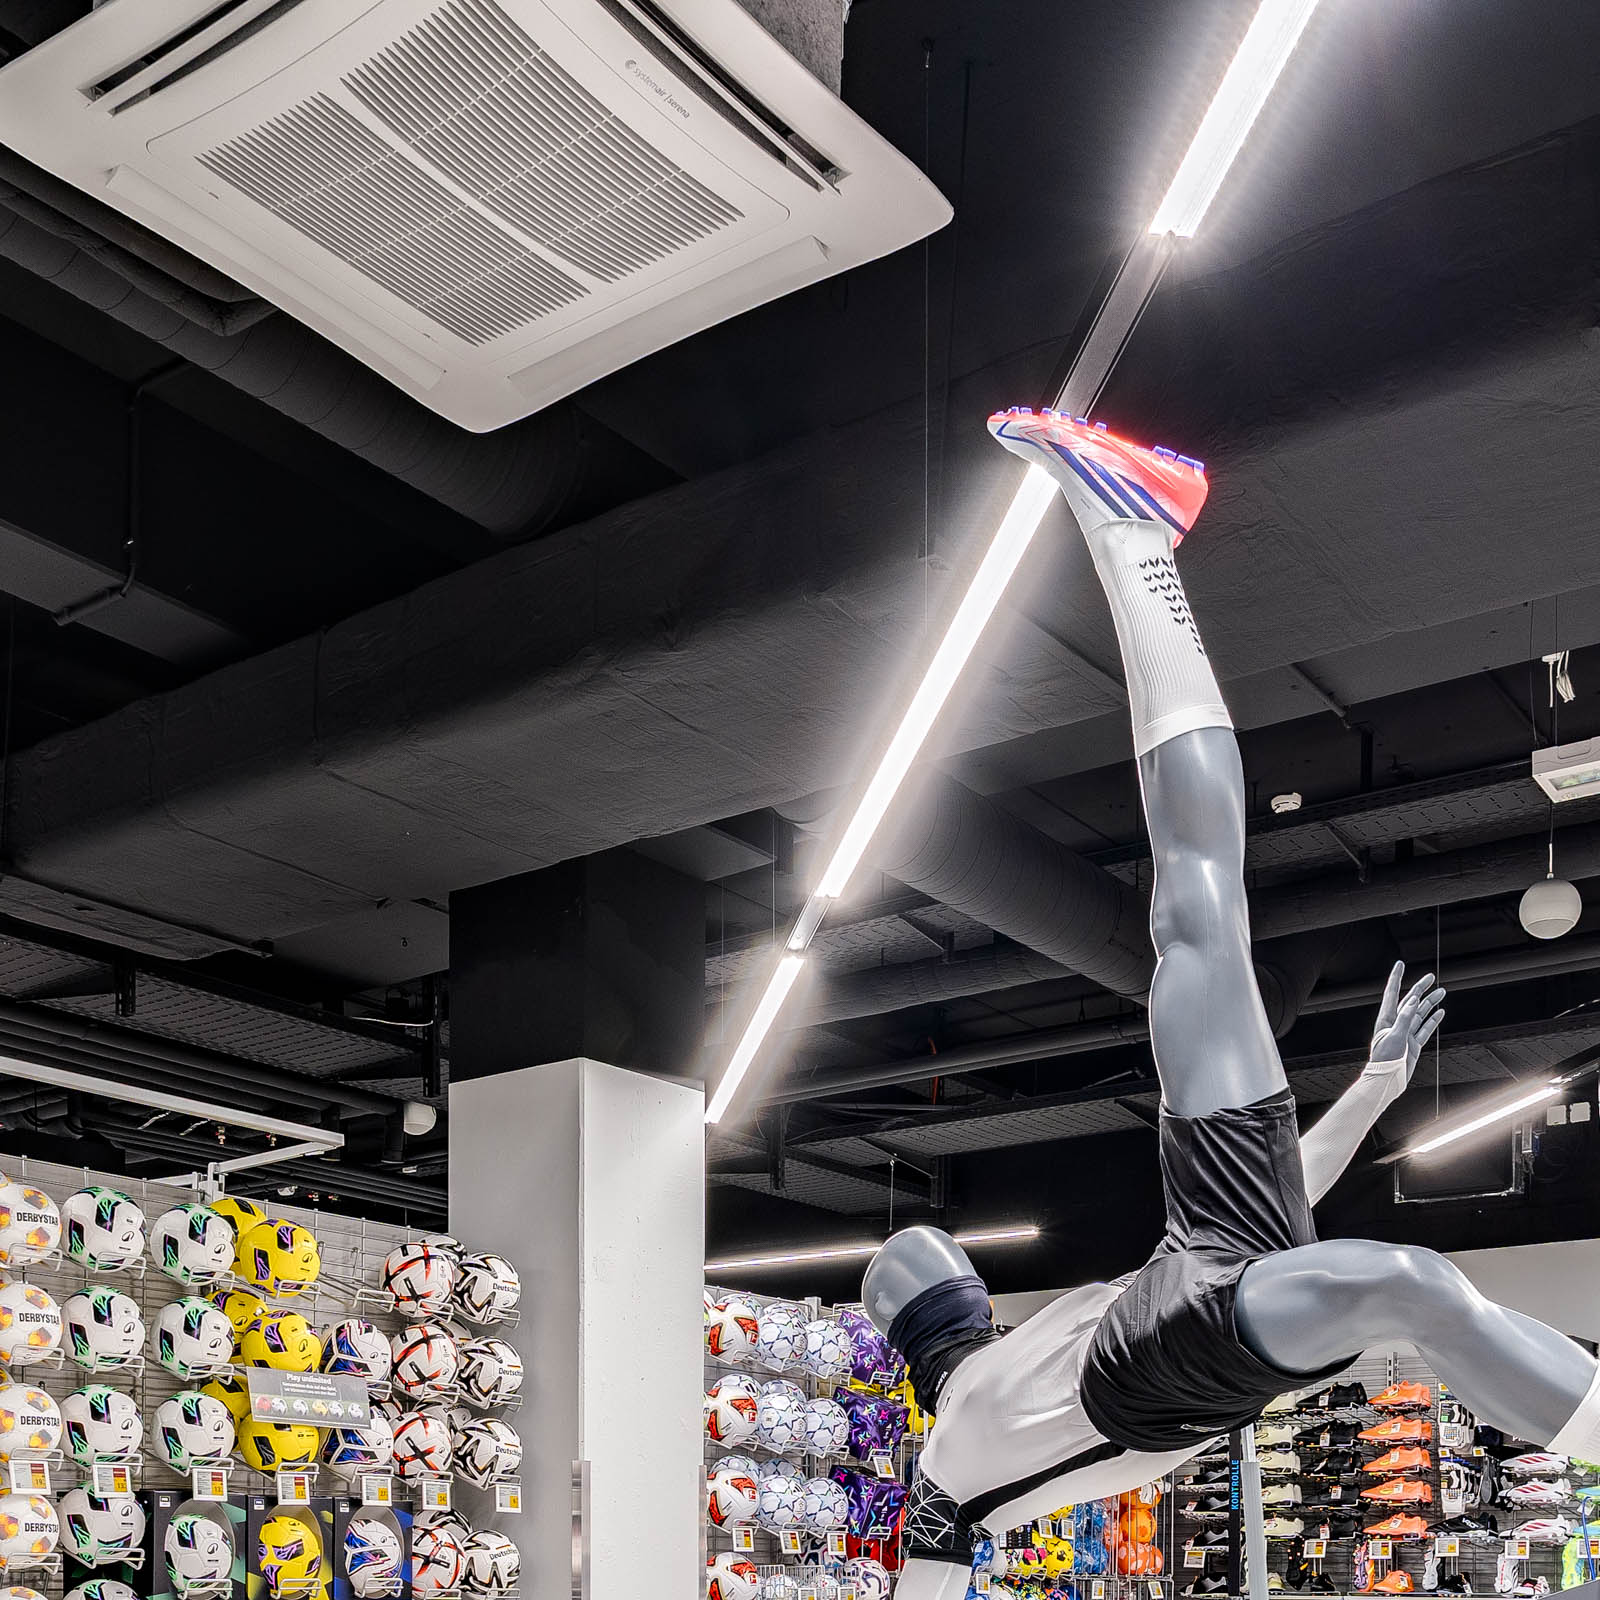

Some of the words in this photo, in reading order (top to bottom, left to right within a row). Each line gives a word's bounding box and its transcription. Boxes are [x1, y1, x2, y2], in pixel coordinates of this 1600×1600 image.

[286, 1373, 301, 1383] Play
[302, 1375, 332, 1385] unlimited
[1231, 1459, 1239, 1511] KONTROLLE
